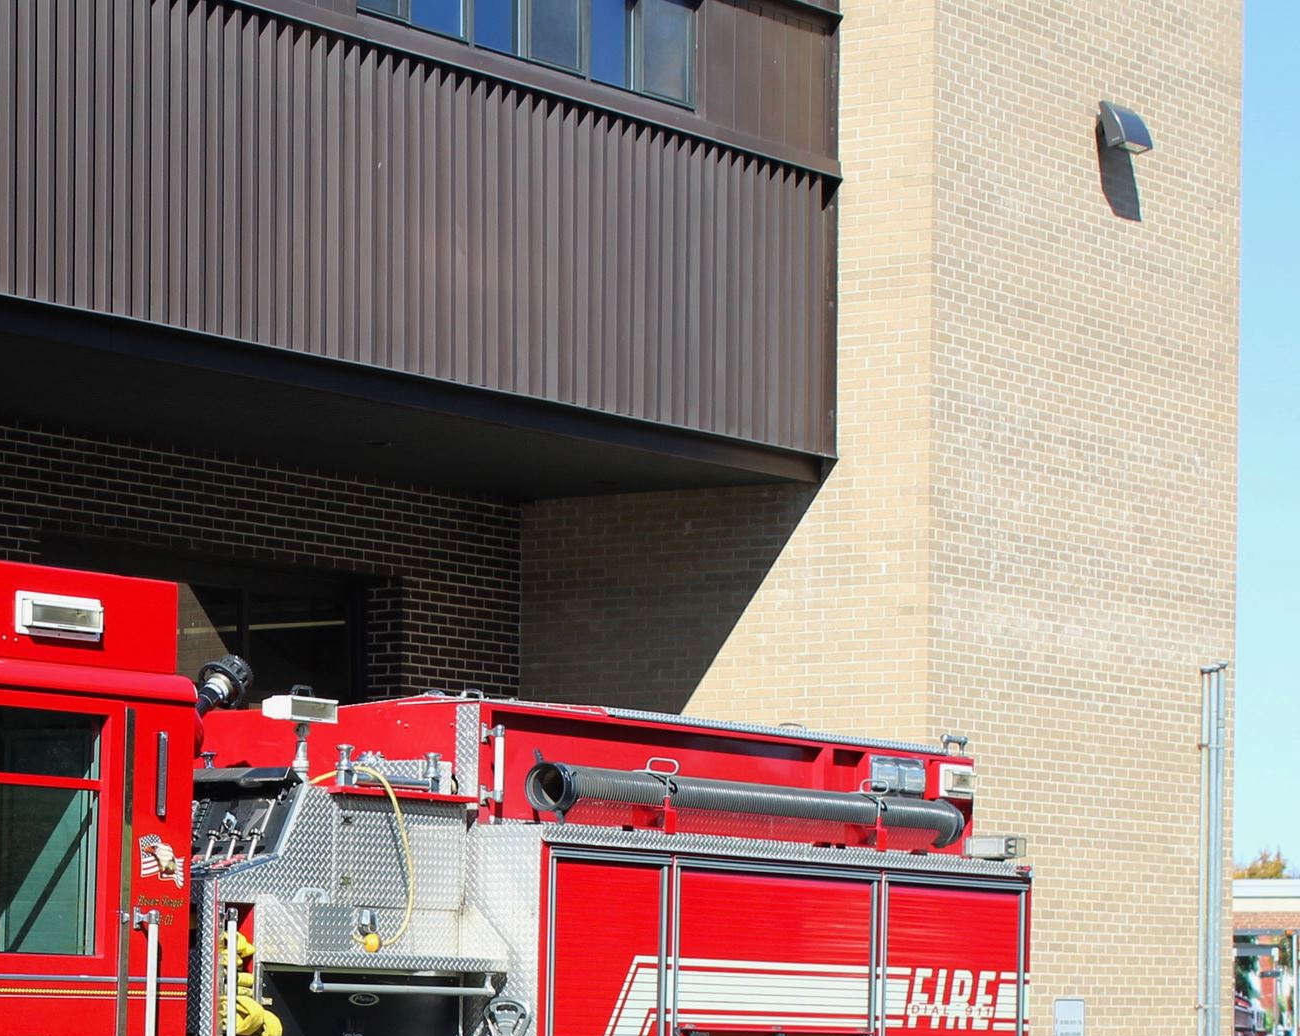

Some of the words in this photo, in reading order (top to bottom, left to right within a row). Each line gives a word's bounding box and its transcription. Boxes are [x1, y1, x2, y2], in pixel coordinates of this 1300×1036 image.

[907, 967, 997, 1031] FIRE
[911, 1004, 950, 1015] DIAL
[965, 1006, 991, 1016] 911
